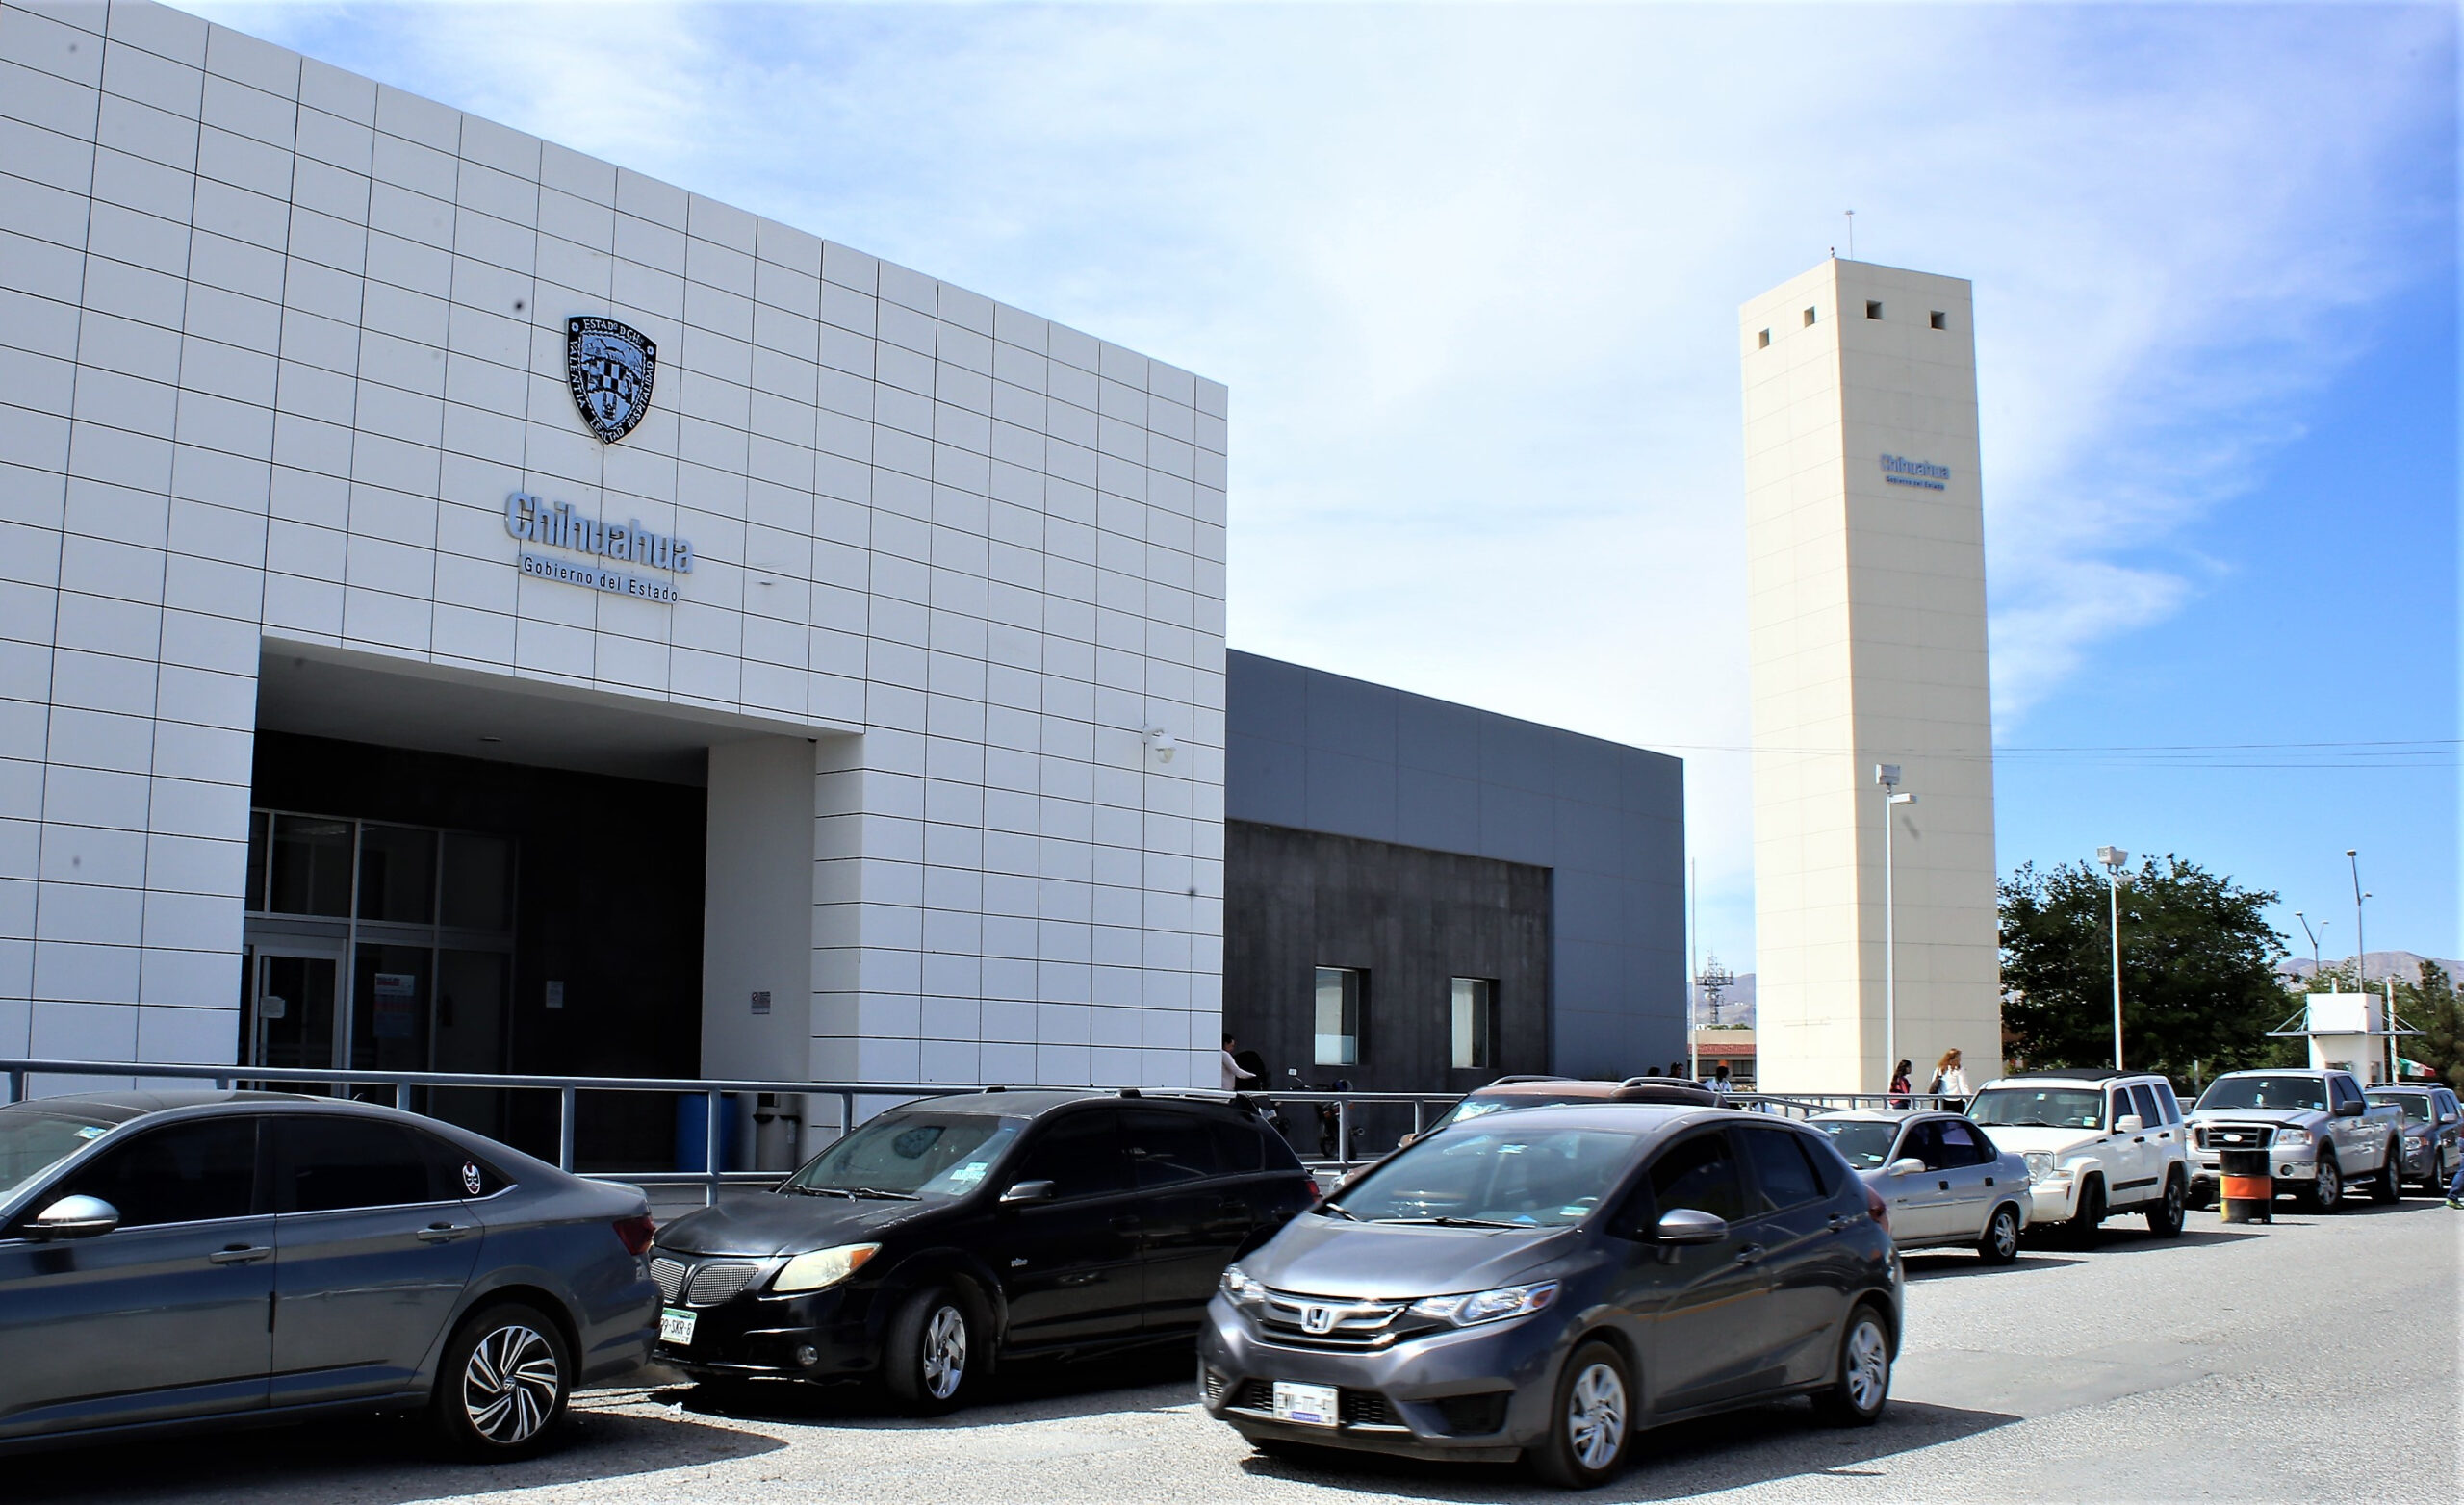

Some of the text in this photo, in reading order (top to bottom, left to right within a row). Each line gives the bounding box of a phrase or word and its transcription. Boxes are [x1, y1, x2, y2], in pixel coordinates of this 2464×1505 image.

[569, 341, 587, 409] VALENTIA
[589, 418, 625, 444] LEALTAD
[504, 492, 693, 574] Chihuahua
[524, 556, 678, 602] Gobierno del Estado
